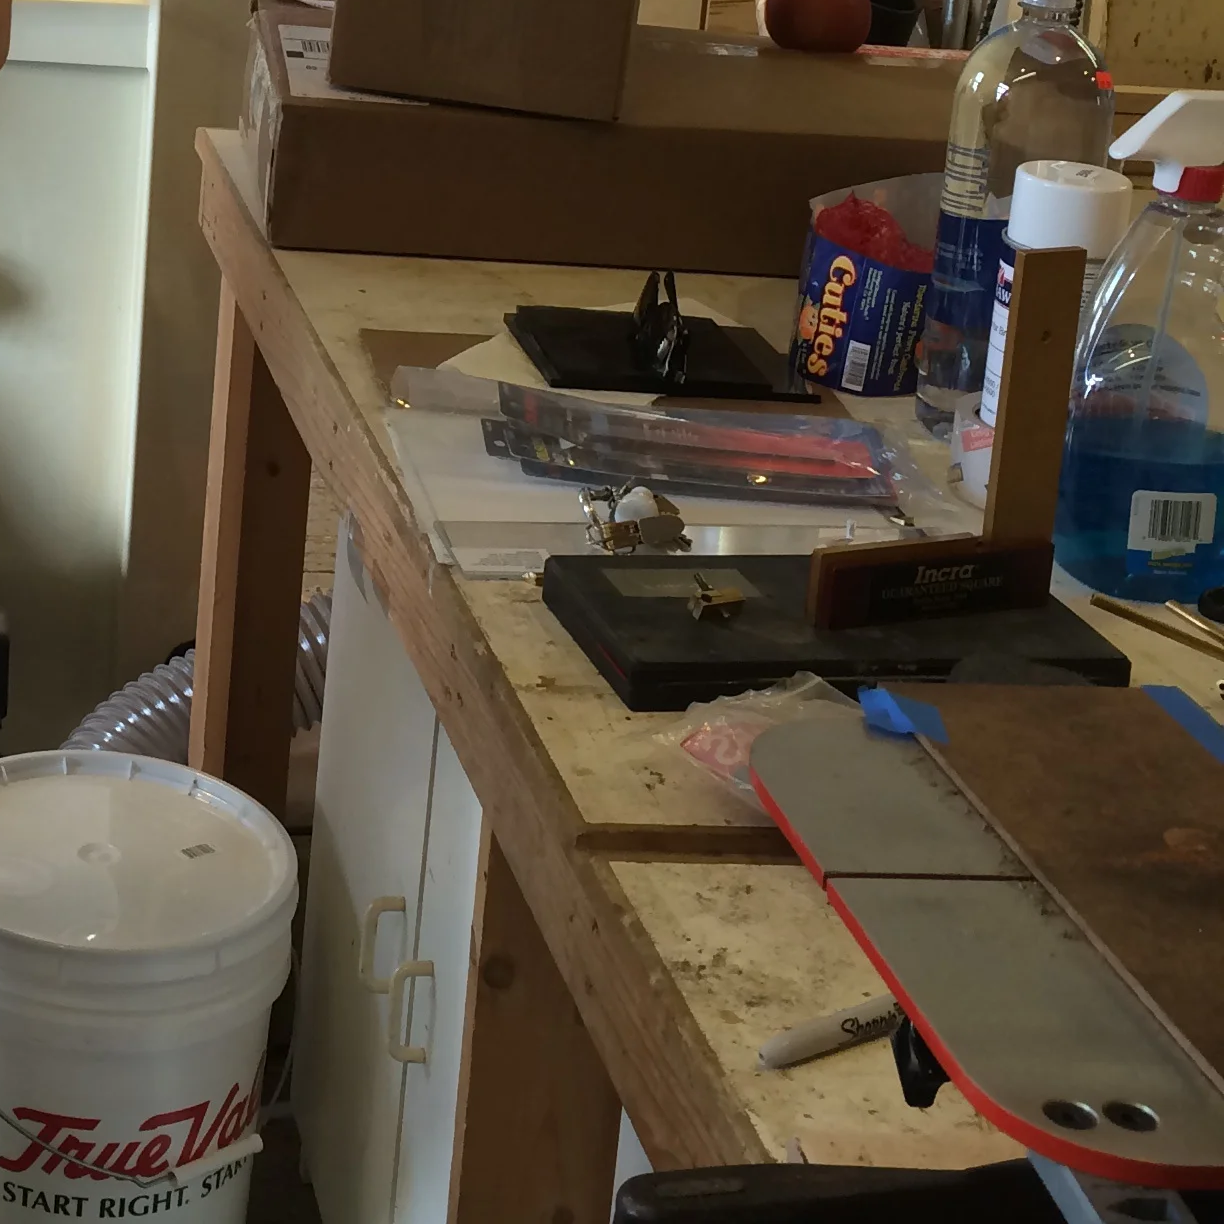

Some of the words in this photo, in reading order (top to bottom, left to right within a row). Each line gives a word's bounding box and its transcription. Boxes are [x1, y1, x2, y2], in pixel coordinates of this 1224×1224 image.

[806, 254, 856, 377] Cuties
[913, 563, 976, 585] Incra
[2, 1181, 89, 1218] START
[98, 1184, 190, 1219] RIGHT.
